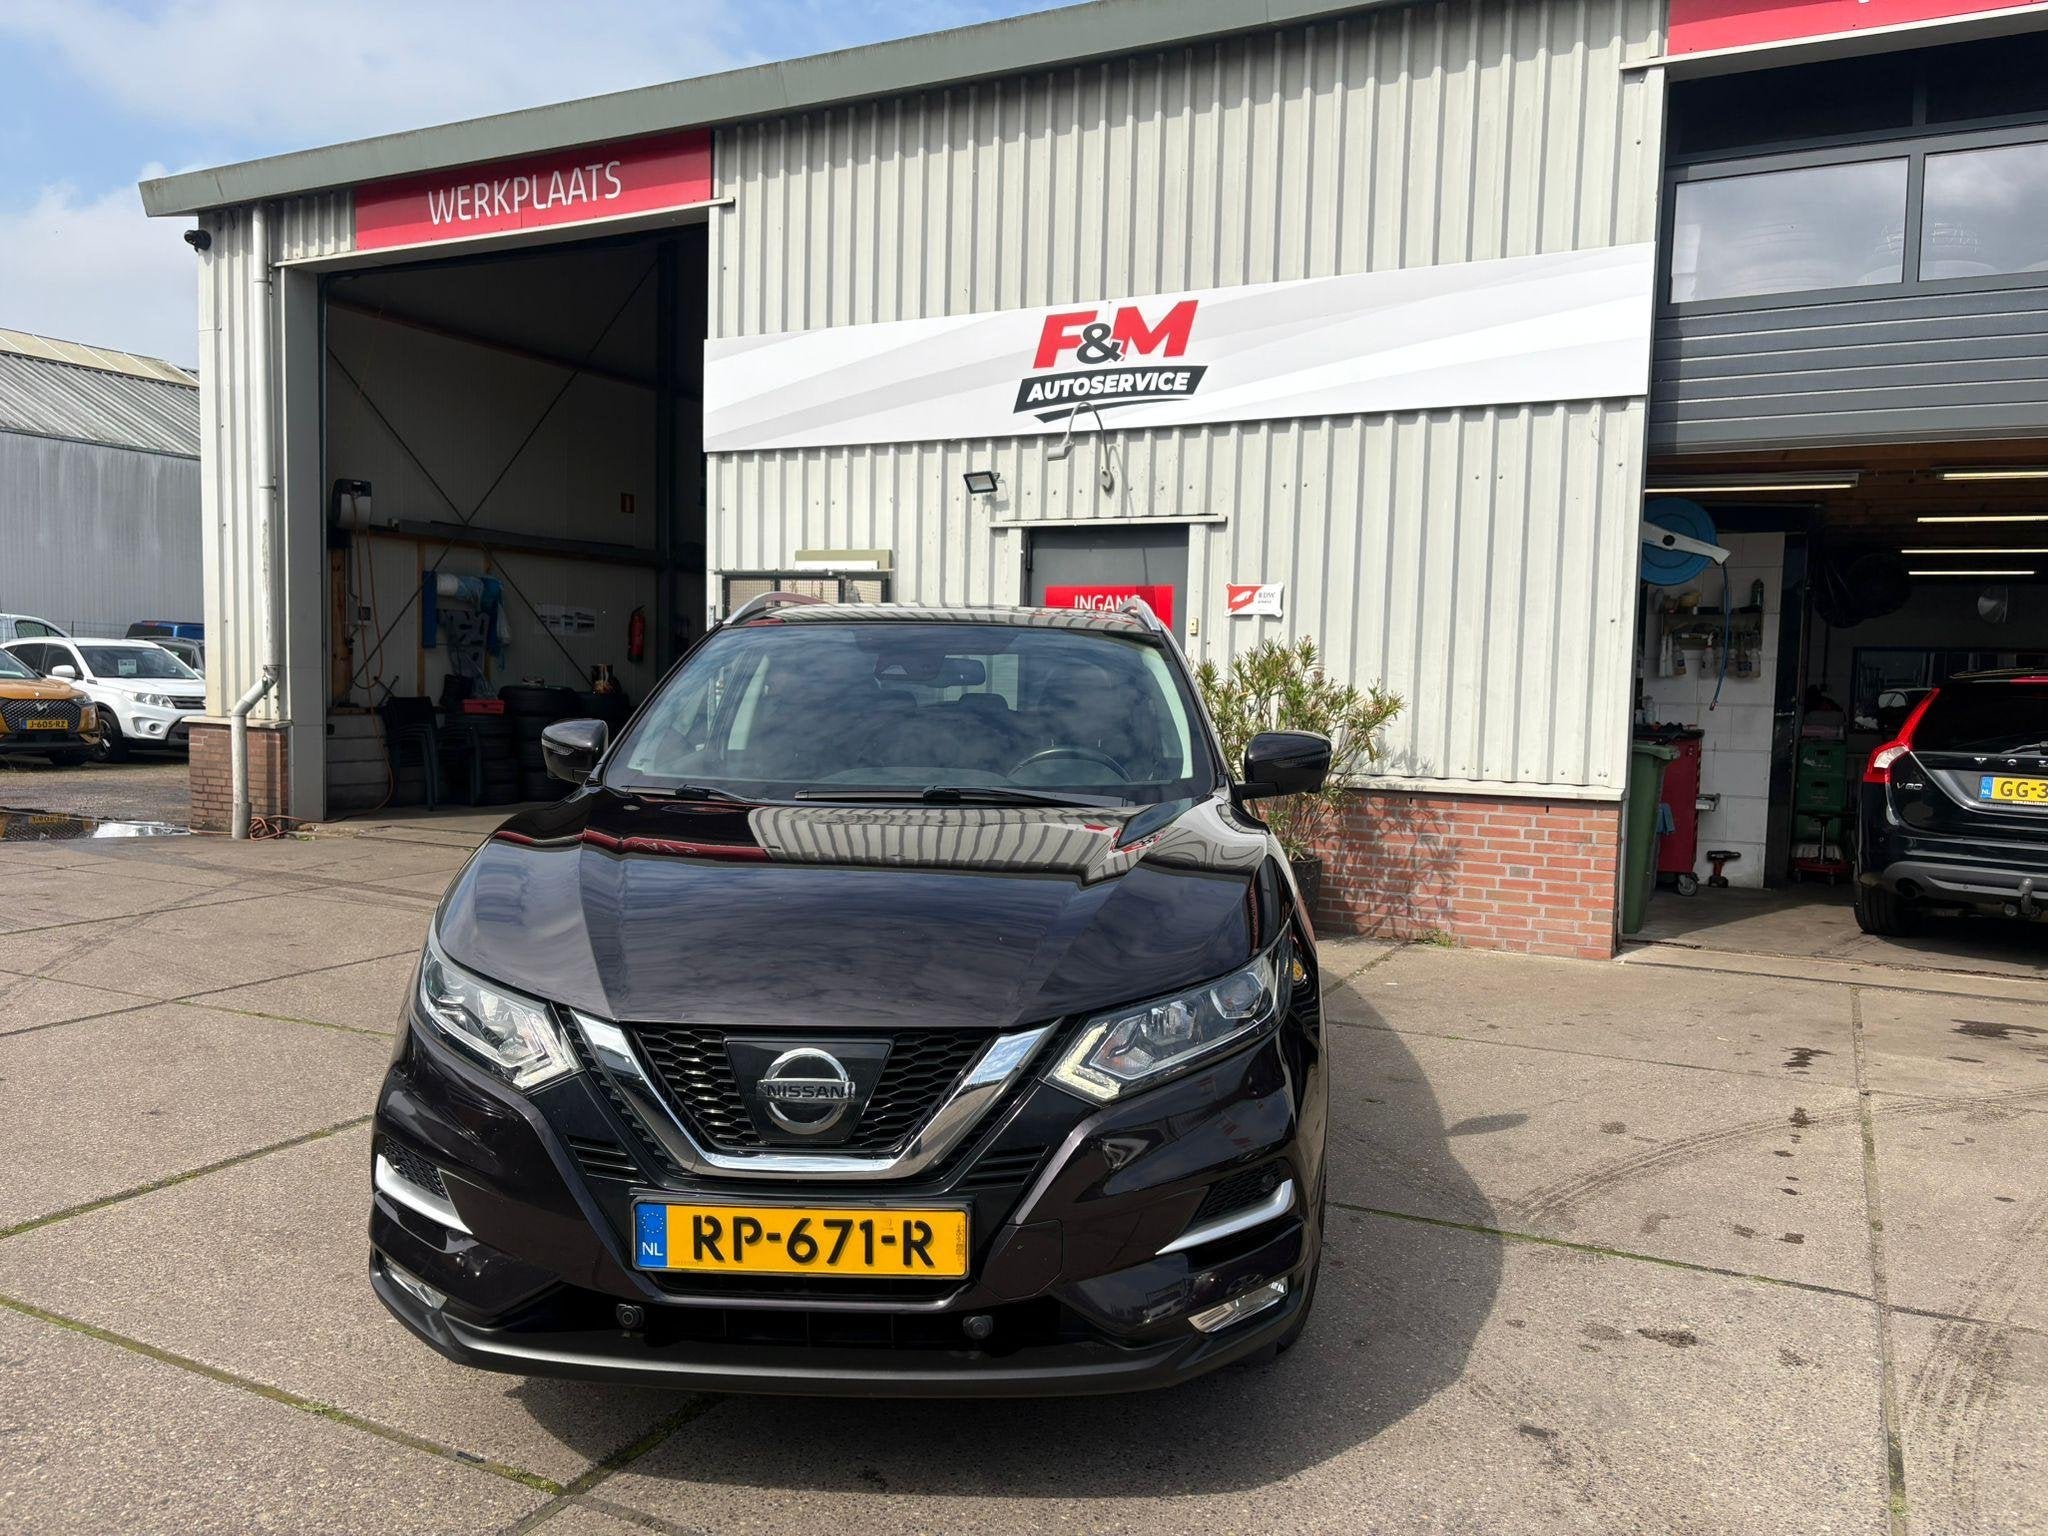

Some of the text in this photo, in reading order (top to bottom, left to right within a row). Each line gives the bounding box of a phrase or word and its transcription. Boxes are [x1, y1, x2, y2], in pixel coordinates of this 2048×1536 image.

[428, 160, 623, 226] WERKPLAATS
[1033, 299, 1199, 369] F&M
[1026, 372, 1191, 403] AUTOSERVICE
[767, 1085, 847, 1098] NISSAN
[642, 1241, 664, 1257] NL
[692, 1214, 935, 1267] RP-671-R
